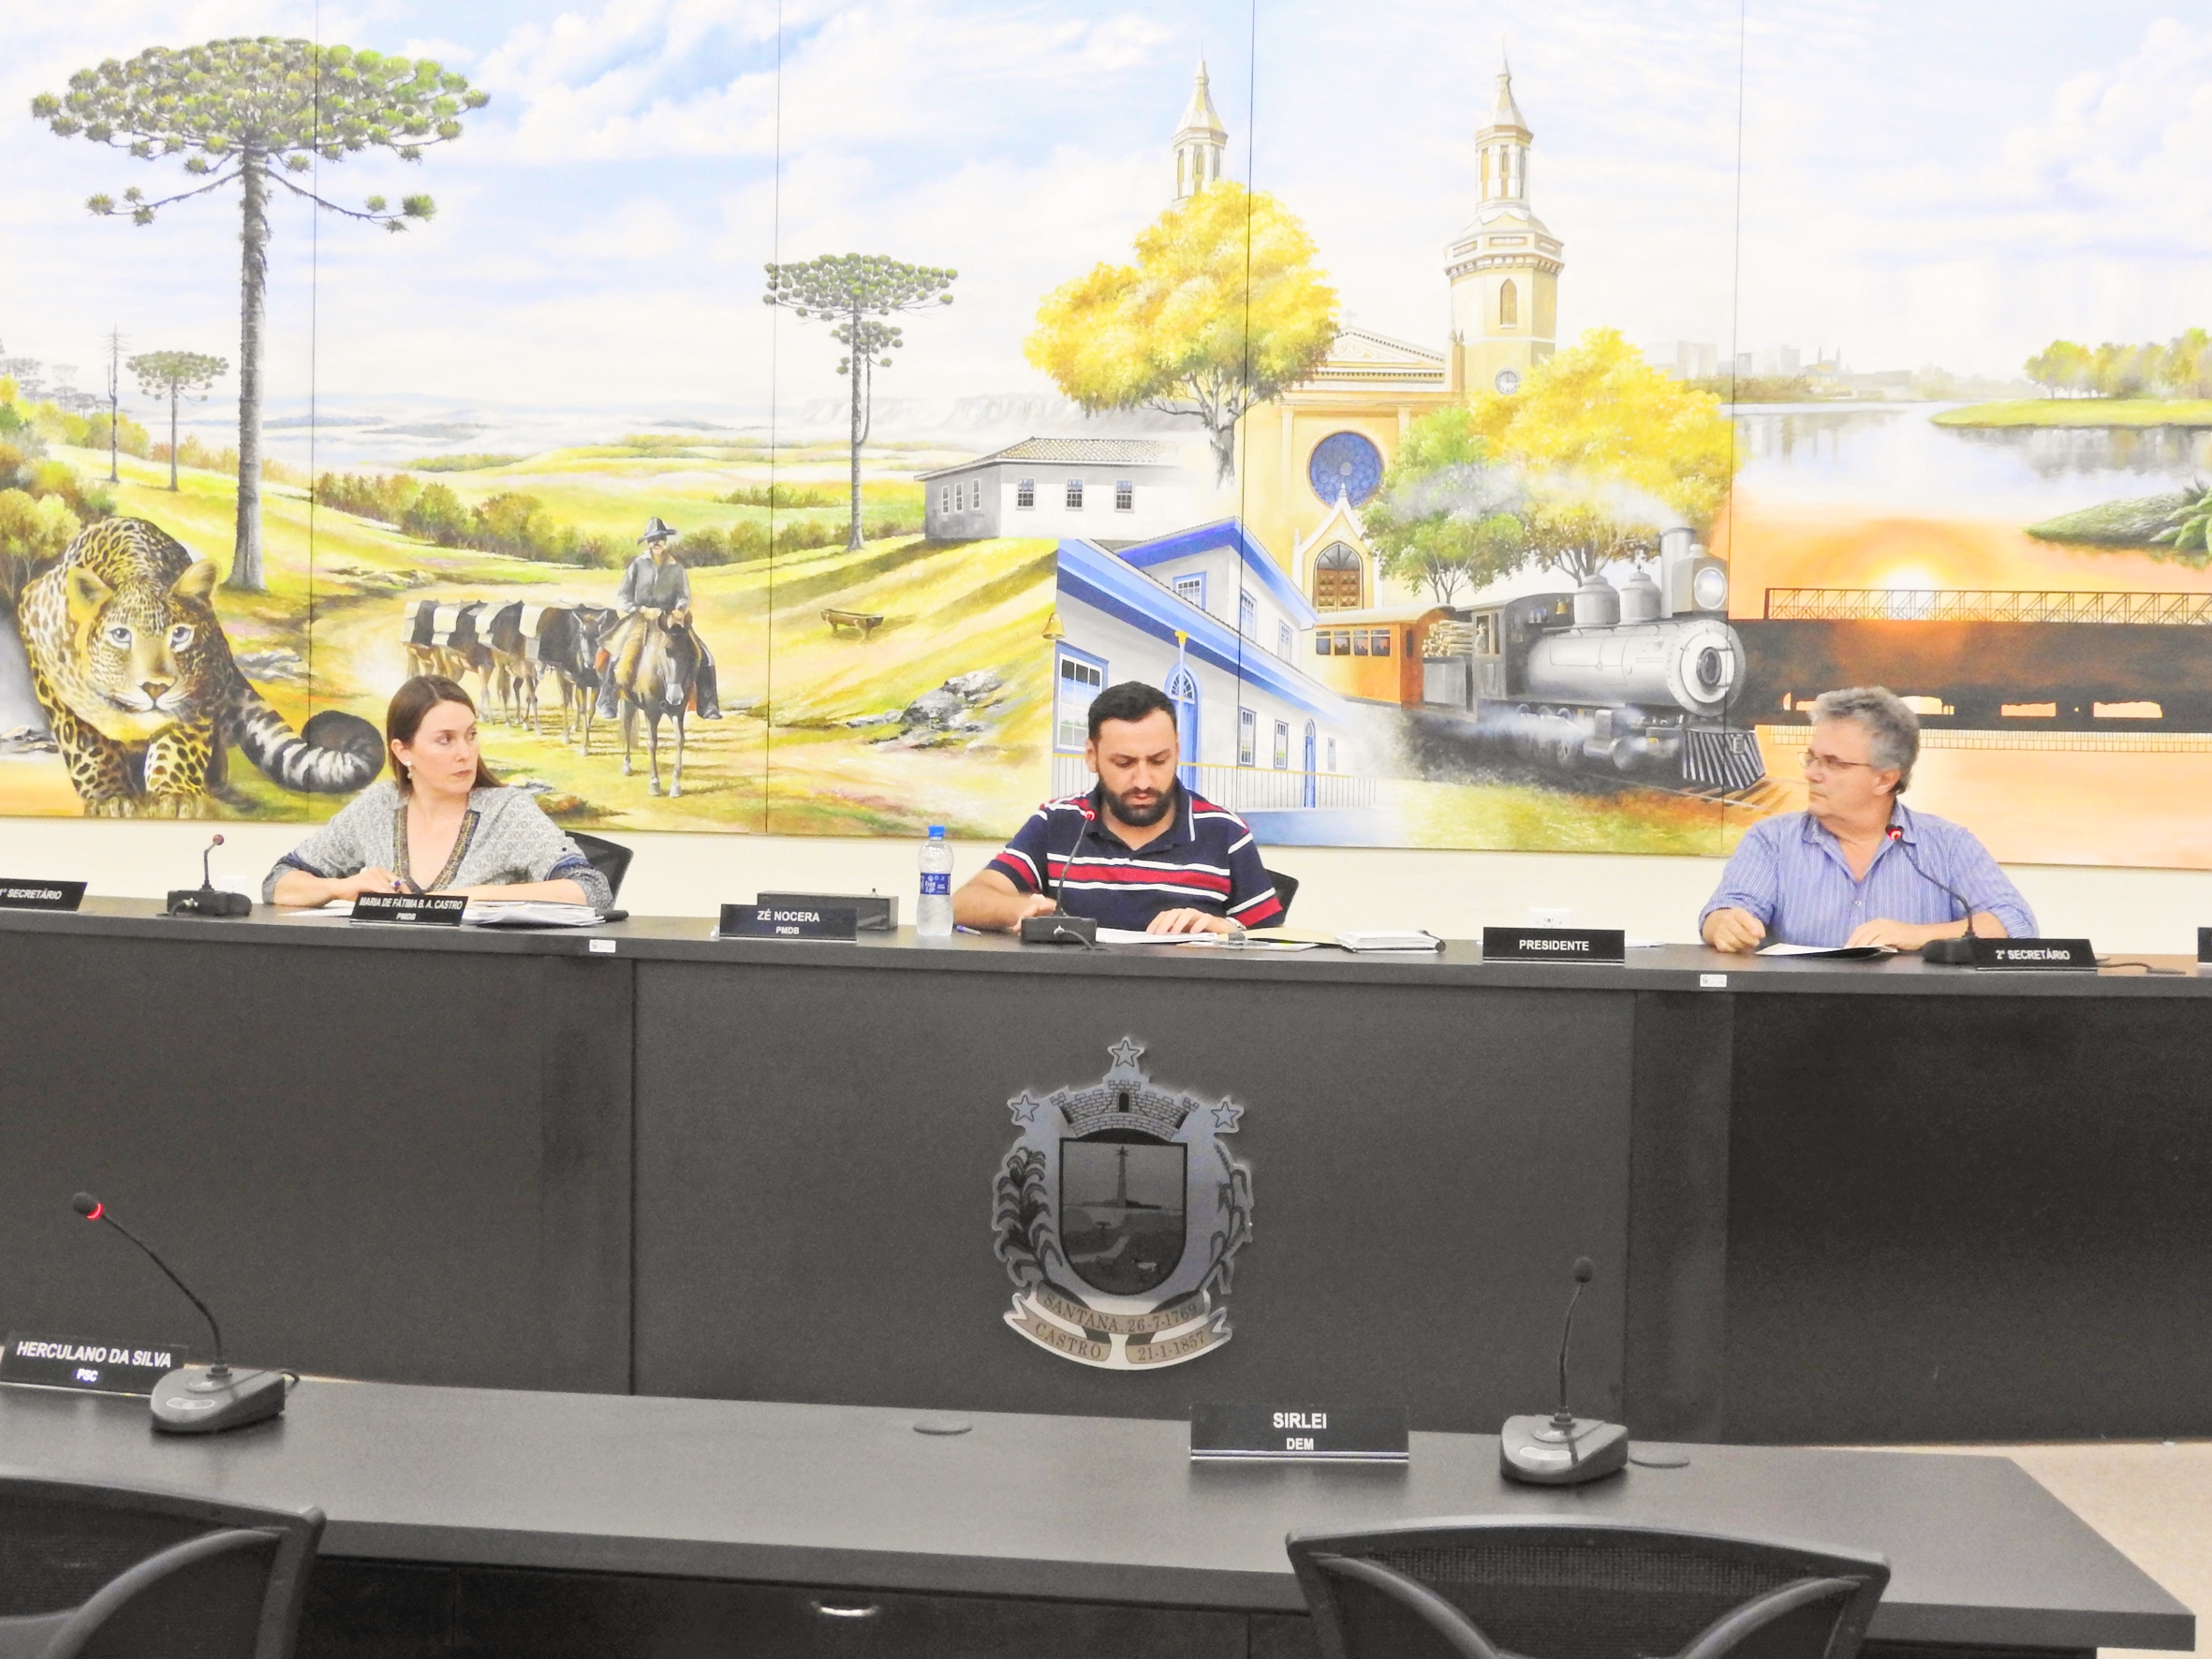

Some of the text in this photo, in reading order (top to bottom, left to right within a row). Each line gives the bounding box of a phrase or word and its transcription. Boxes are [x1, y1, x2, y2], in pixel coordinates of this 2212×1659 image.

[7, 888, 63, 900] SECRETÁRIO
[359, 897, 381, 906] MARIA
[381, 898, 392, 907] DE
[391, 897, 417, 908] FÁTIMA
[434, 901, 463, 910] CASTRO
[757, 908, 820, 922] ZÉ NOCERA
[775, 926, 800, 934] PMDB
[1519, 939, 1589, 951] PRESIDENTE
[2007, 947, 2071, 961] SECRETÁRIO
[1035, 1322, 1102, 1359] CASTRO
[17, 1341, 171, 1368] HERCULANO DA SILVA
[76, 1368, 98, 1382] PSC
[1273, 1412, 1327, 1429] SIRLEI
[1286, 1437, 1314, 1450] DEM
